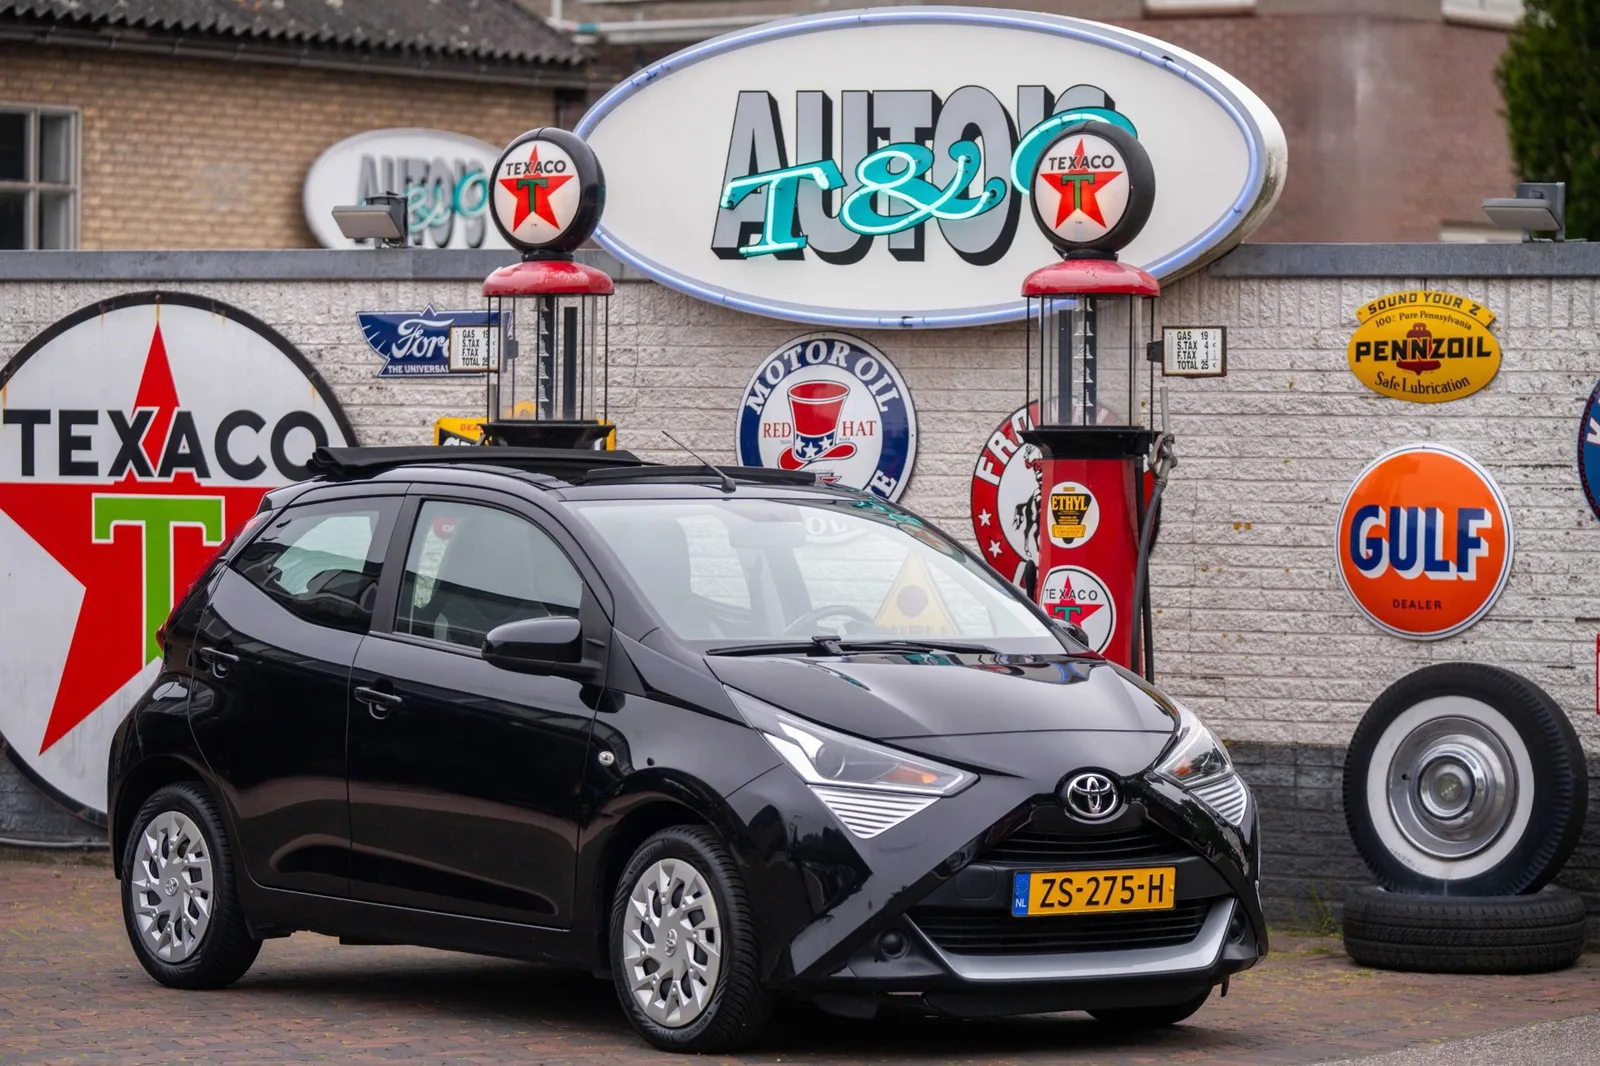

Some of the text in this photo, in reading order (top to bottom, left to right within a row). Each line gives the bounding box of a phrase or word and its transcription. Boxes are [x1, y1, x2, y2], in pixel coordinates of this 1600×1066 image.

[506, 160, 567, 176] TEXACO
[1048, 155, 1115, 171] TEXACO
[711, 85, 1118, 265] AUTO'
[1368, 292, 1481, 316] SOUND YOUR Z
[1399, 312, 1418, 321] Pure
[1420, 310, 1473, 331] Pennsylvania
[462, 330, 475, 338] GAS
[1177, 331, 1209, 341] GAS 19
[462, 339, 480, 348] S.TAX
[1177, 341, 1209, 350] S.TAX 4
[1355, 336, 1493, 362] PENNZOIL
[462, 348, 478, 357] F.TAX
[1177, 351, 1196, 360] F.TAX
[388, 365, 403, 374] THE
[462, 357, 480, 367] TOTAL
[1177, 360, 1209, 370] TOTAL 25
[746, 340, 901, 416] MOTOR OIL
[1374, 371, 1471, 395] Safe Lubrication
[763, 420, 877, 439] RED HAT
[2, 408, 329, 481] TEXACO
[1051, 495, 1088, 511] ETHYL
[1350, 505, 1492, 581] GULF
[1392, 598, 1443, 610] DEALER
[1015, 873, 1165, 909] NL ZS-275-H
